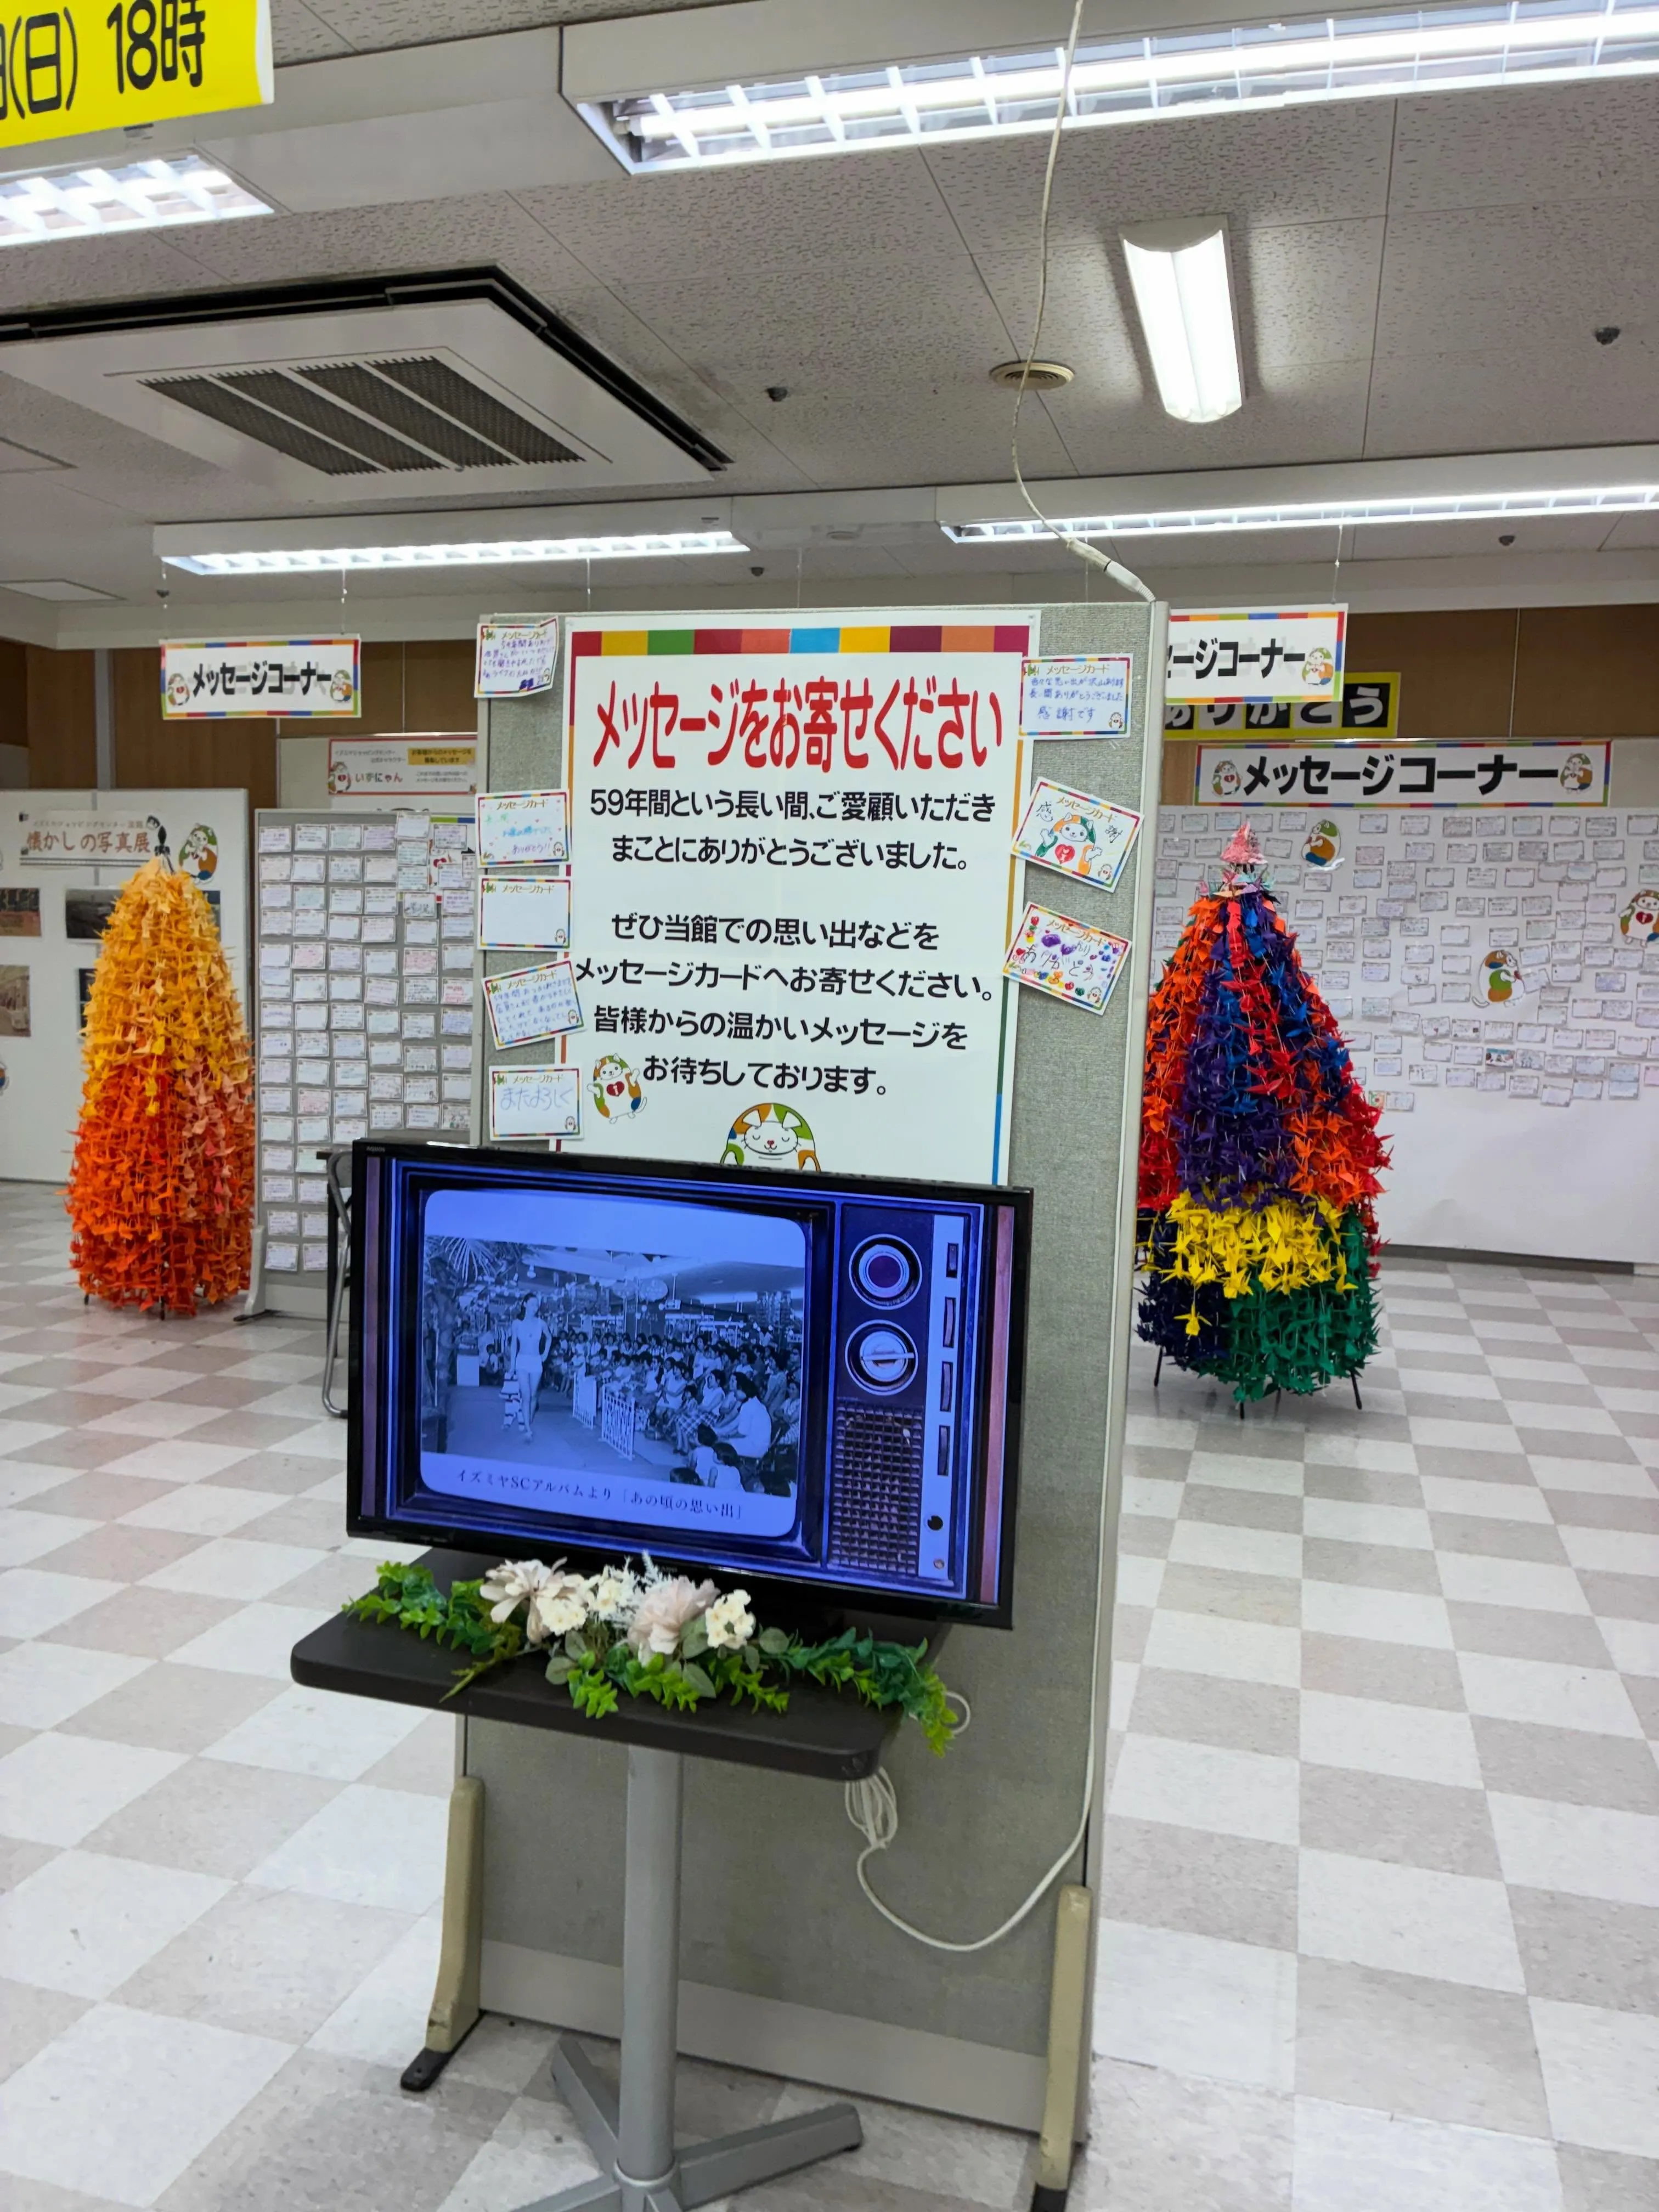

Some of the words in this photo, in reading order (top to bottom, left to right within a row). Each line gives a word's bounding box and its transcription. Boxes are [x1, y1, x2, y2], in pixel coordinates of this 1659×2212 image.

[0, 7, 77, 120] (日)
[107, 0, 206, 94] 18時
[1047, 664, 1110, 675] メッセージカード
[1167, 637, 1306, 679] ージコーナー
[193, 661, 331, 696] メッセージコーナー
[593, 675, 1002, 773] メッセージをお寄せください
[1037, 706, 1096, 724] 感謝です
[1243, 754, 1559, 796] メッセージコーナー
[496, 799, 549, 810] メッセージカード
[590, 788, 996, 822] 59年間という長い間、ご愛顧いただき
[1056, 797, 1118, 823] メッセージカード
[27, 830, 151, 853] 懐かしの写真展
[612, 834, 967, 871] まことにありがとうございました。
[502, 884, 555, 894] メッセージカード
[612, 913, 940, 950] ぜひ当館での思い出などを
[575, 958, 992, 1002] メッセージカードへお寄せください。
[594, 1005, 967, 1050] 皆様からの温かいメッセージを
[513, 1074, 563, 1085] メッセージカード
[643, 1054, 887, 1096] お待ちしております。
[500, 1085, 574, 1111] またよろしく
